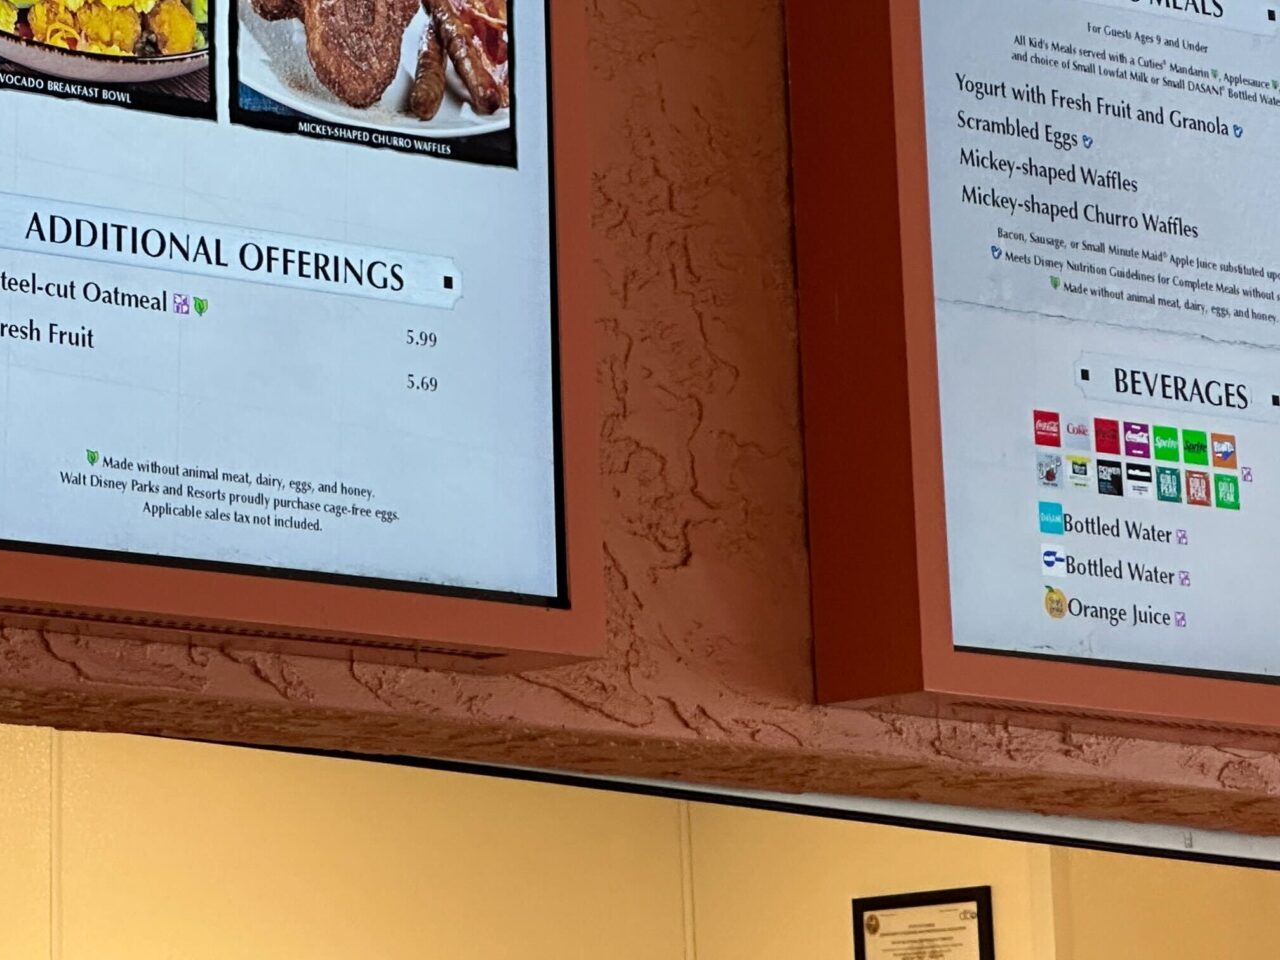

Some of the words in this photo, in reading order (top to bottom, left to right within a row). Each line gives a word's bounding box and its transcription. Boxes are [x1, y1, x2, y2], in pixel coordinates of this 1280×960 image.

[1087, 21, 1102, 35] For
[1103, 25, 1132, 40] Guests
[1134, 31, 1155, 46] Ages
[1163, 37, 1180, 49] and
[1182, 39, 1209, 54] Under
[47, 80, 99, 98] BREAKFAST
[102, 89, 132, 104] BOWL
[955, 72, 1007, 101] Yogurt
[1011, 84, 1046, 105] with
[1051, 88, 1092, 113] Fresh
[1096, 96, 1132, 120] Fruit
[1136, 106, 1164, 125] and
[1169, 110, 1229, 136] Granola
[298, 121, 370, 142] MICKEY-SHAPED
[371, 133, 412, 149] CHURRO
[413, 139, 451, 155] WAFFLES
[957, 109, 1040, 141] Scrambled
[1044, 124, 1078, 152] Eggs
[959, 147, 1076, 186] Mickey-shaped
[1079, 166, 1138, 193] Waffles
[961, 184, 1079, 223] Mickey-shaped
[1083, 203, 1139, 229] Churro
[1142, 212, 1199, 239] Waffles
[24, 211, 229, 267] ADDITIONAL
[238, 242, 404, 292] OFFERINGS
[82, 281, 167, 312] Oatmeal
[1063, 281, 1089, 296] Made
[1089, 286, 1124, 301] without
[1126, 293, 1156, 305] animal
[1233, 307, 1250, 319] and
[49, 322, 94, 349] Fruit
[406, 329, 437, 348] 5.99
[407, 373, 438, 392] 5.69
[1114, 367, 1249, 410] BEVERAGES
[102, 456, 134, 471] Made
[136, 460, 180, 477] without
[182, 465, 219, 481] animal
[317, 481, 338, 494] and
[59, 471, 87, 486] Walt
[90, 474, 128, 494] Disney
[131, 479, 160, 494] Parks
[162, 483, 183, 497] and
[187, 485, 226, 502] Resorts
[229, 492, 270, 509] proudly
[273, 496, 321, 512] purchase
[323, 503, 372, 518] cage-free
[142, 501, 202, 519] Applicable
[204, 507, 231, 522] sales
[233, 511, 251, 524] tax
[252, 514, 271, 526] not
[274, 514, 323, 532] included.
[1064, 513, 1121, 538] Bottled
[1124, 520, 1173, 544] Water
[1066, 555, 1123, 580] Bottled
[1127, 561, 1175, 585] Water
[1068, 597, 1127, 627] Orange
[1132, 604, 1171, 626] Juice
